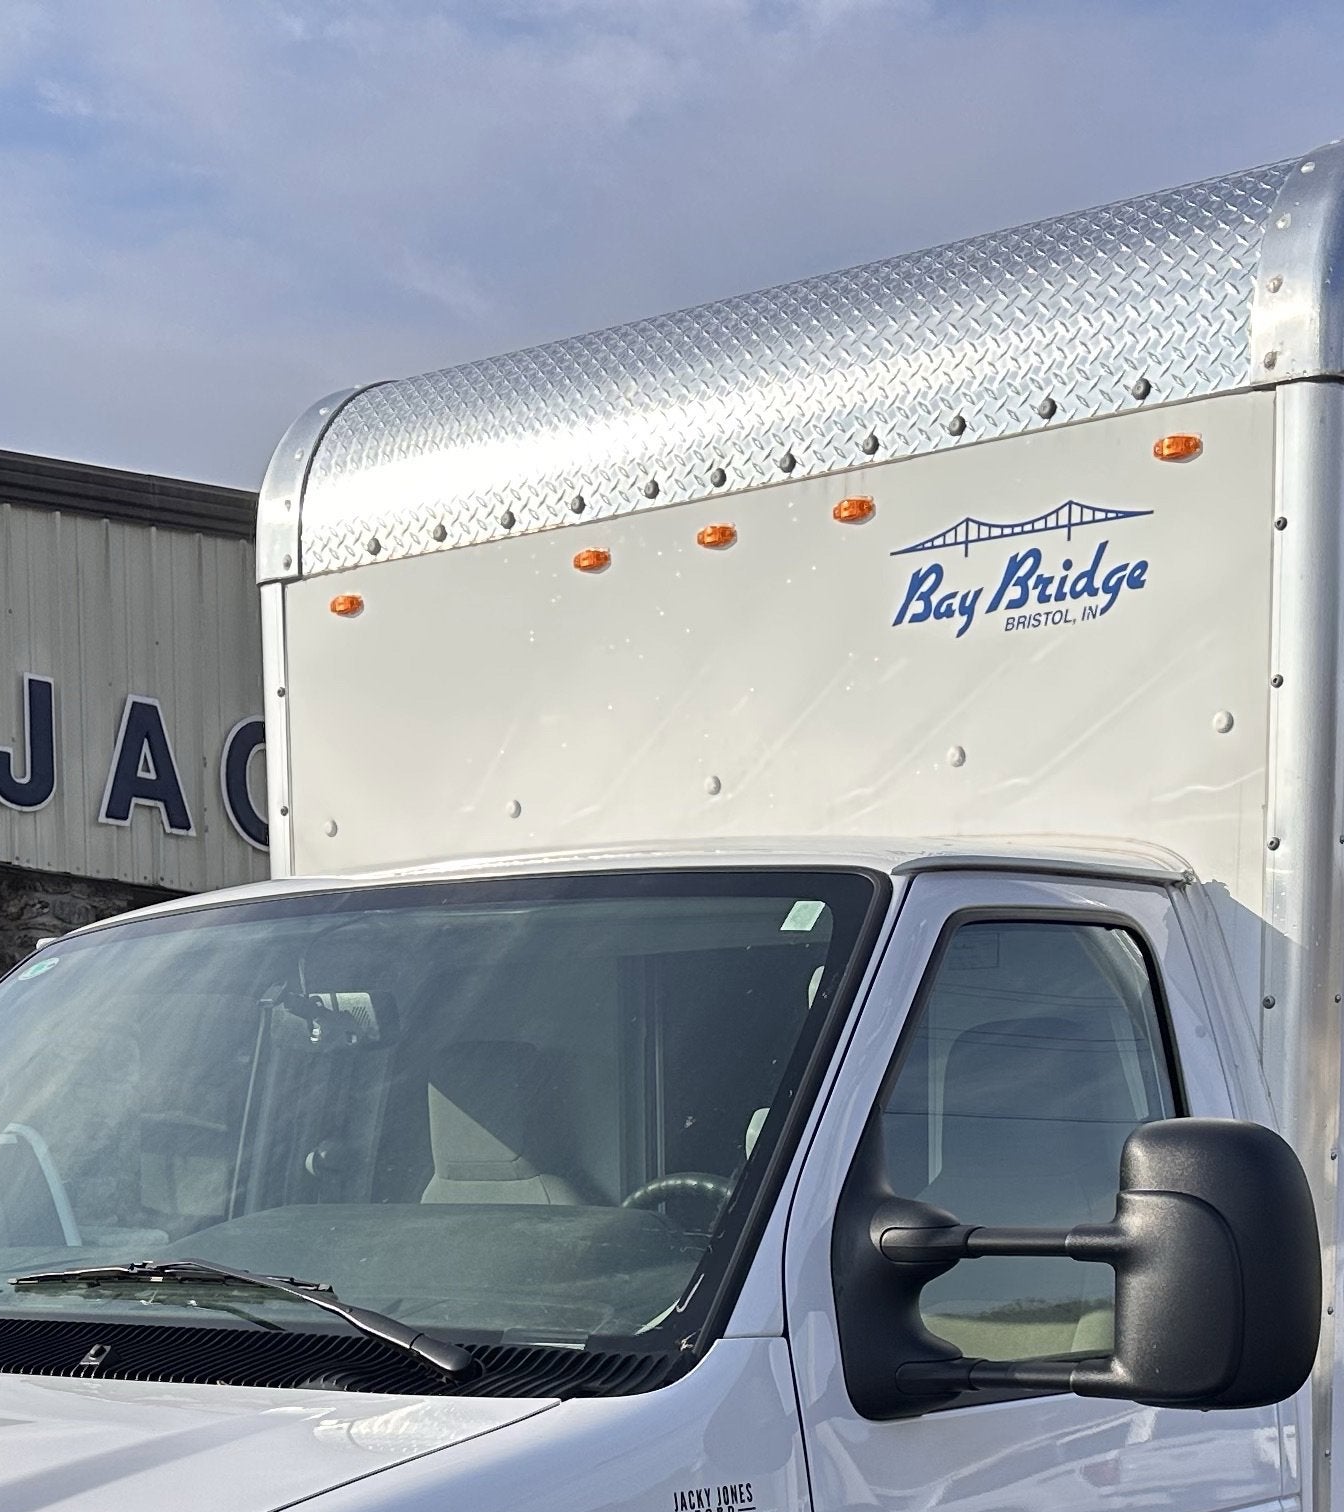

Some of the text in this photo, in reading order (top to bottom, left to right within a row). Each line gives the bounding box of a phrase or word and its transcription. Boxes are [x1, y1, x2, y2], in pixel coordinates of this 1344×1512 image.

[892, 540, 1149, 638] Bay Bridge
[1004, 604, 1099, 632] BRISTOL, IN
[674, 1482, 753, 1512] JACKY JONES
